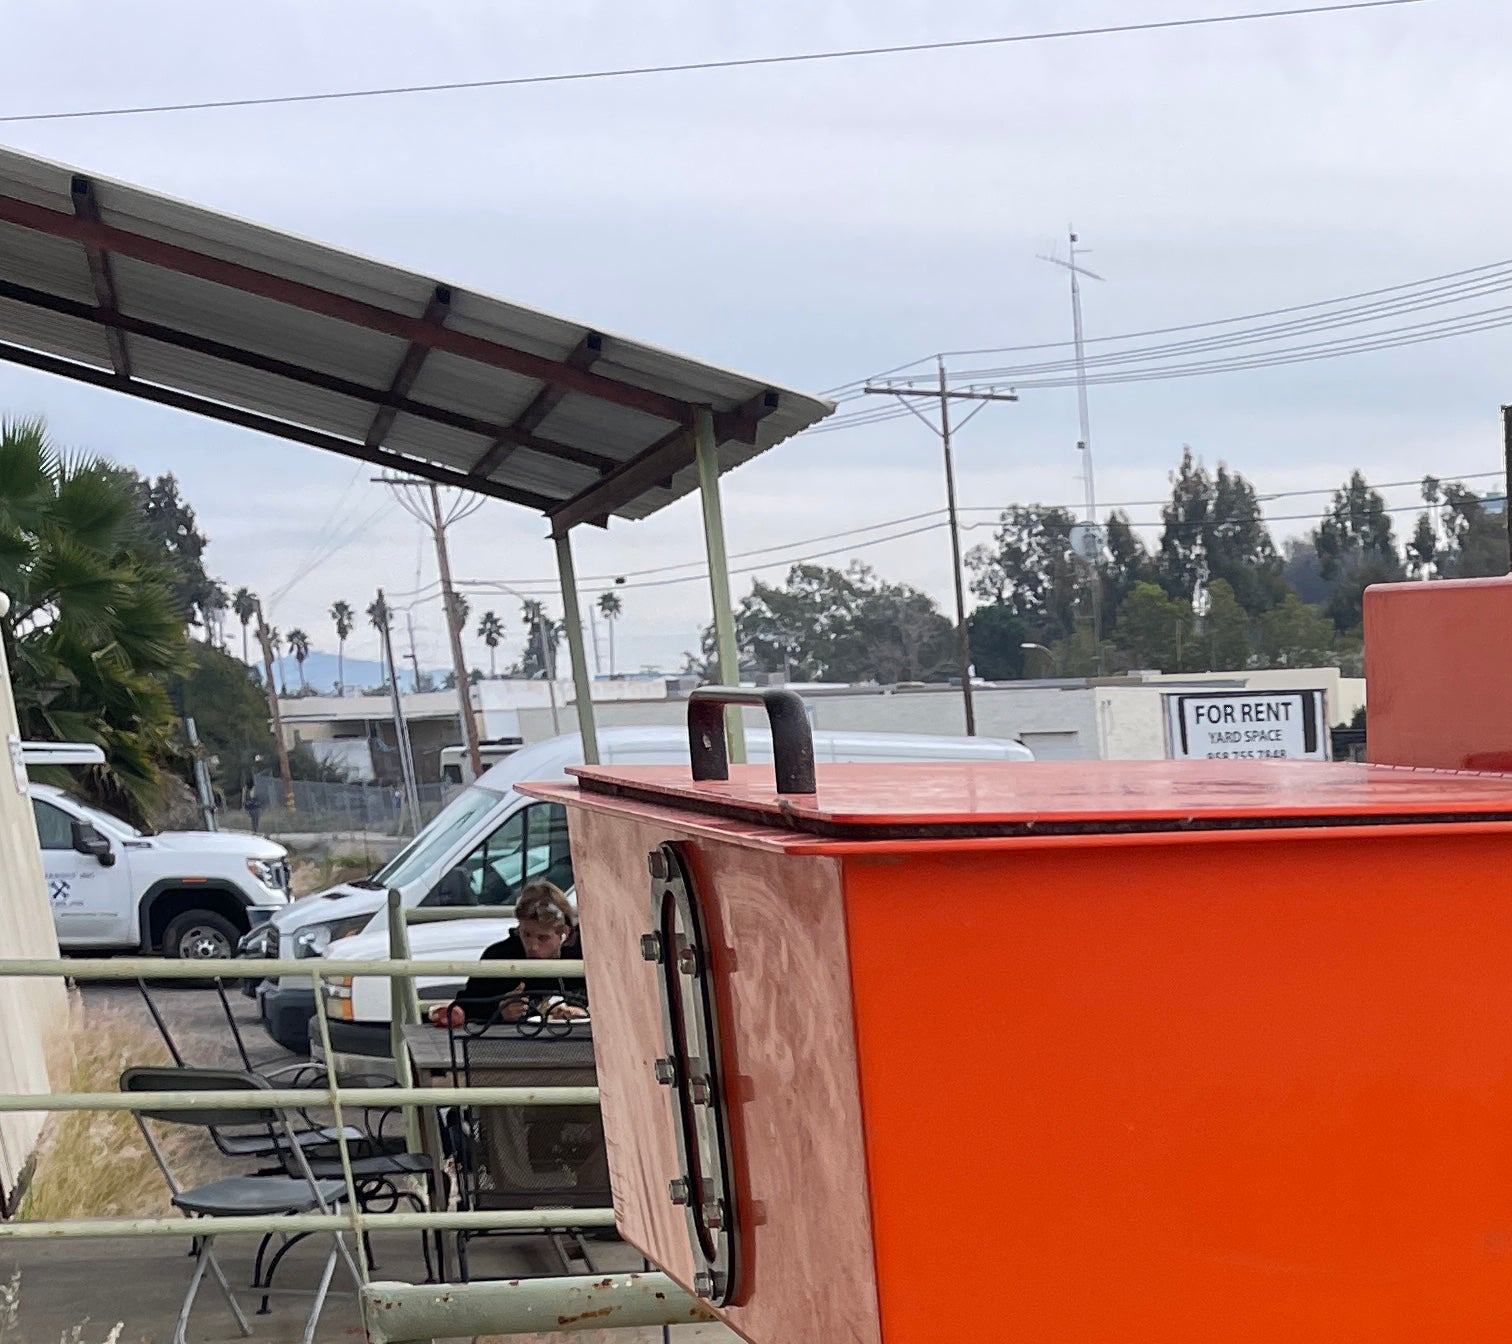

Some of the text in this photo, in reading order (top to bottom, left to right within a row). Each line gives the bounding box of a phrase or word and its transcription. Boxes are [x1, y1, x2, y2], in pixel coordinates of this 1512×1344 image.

[1195, 701, 1292, 724] FOR RENT
[1208, 729, 1283, 744] YARD SPACE
